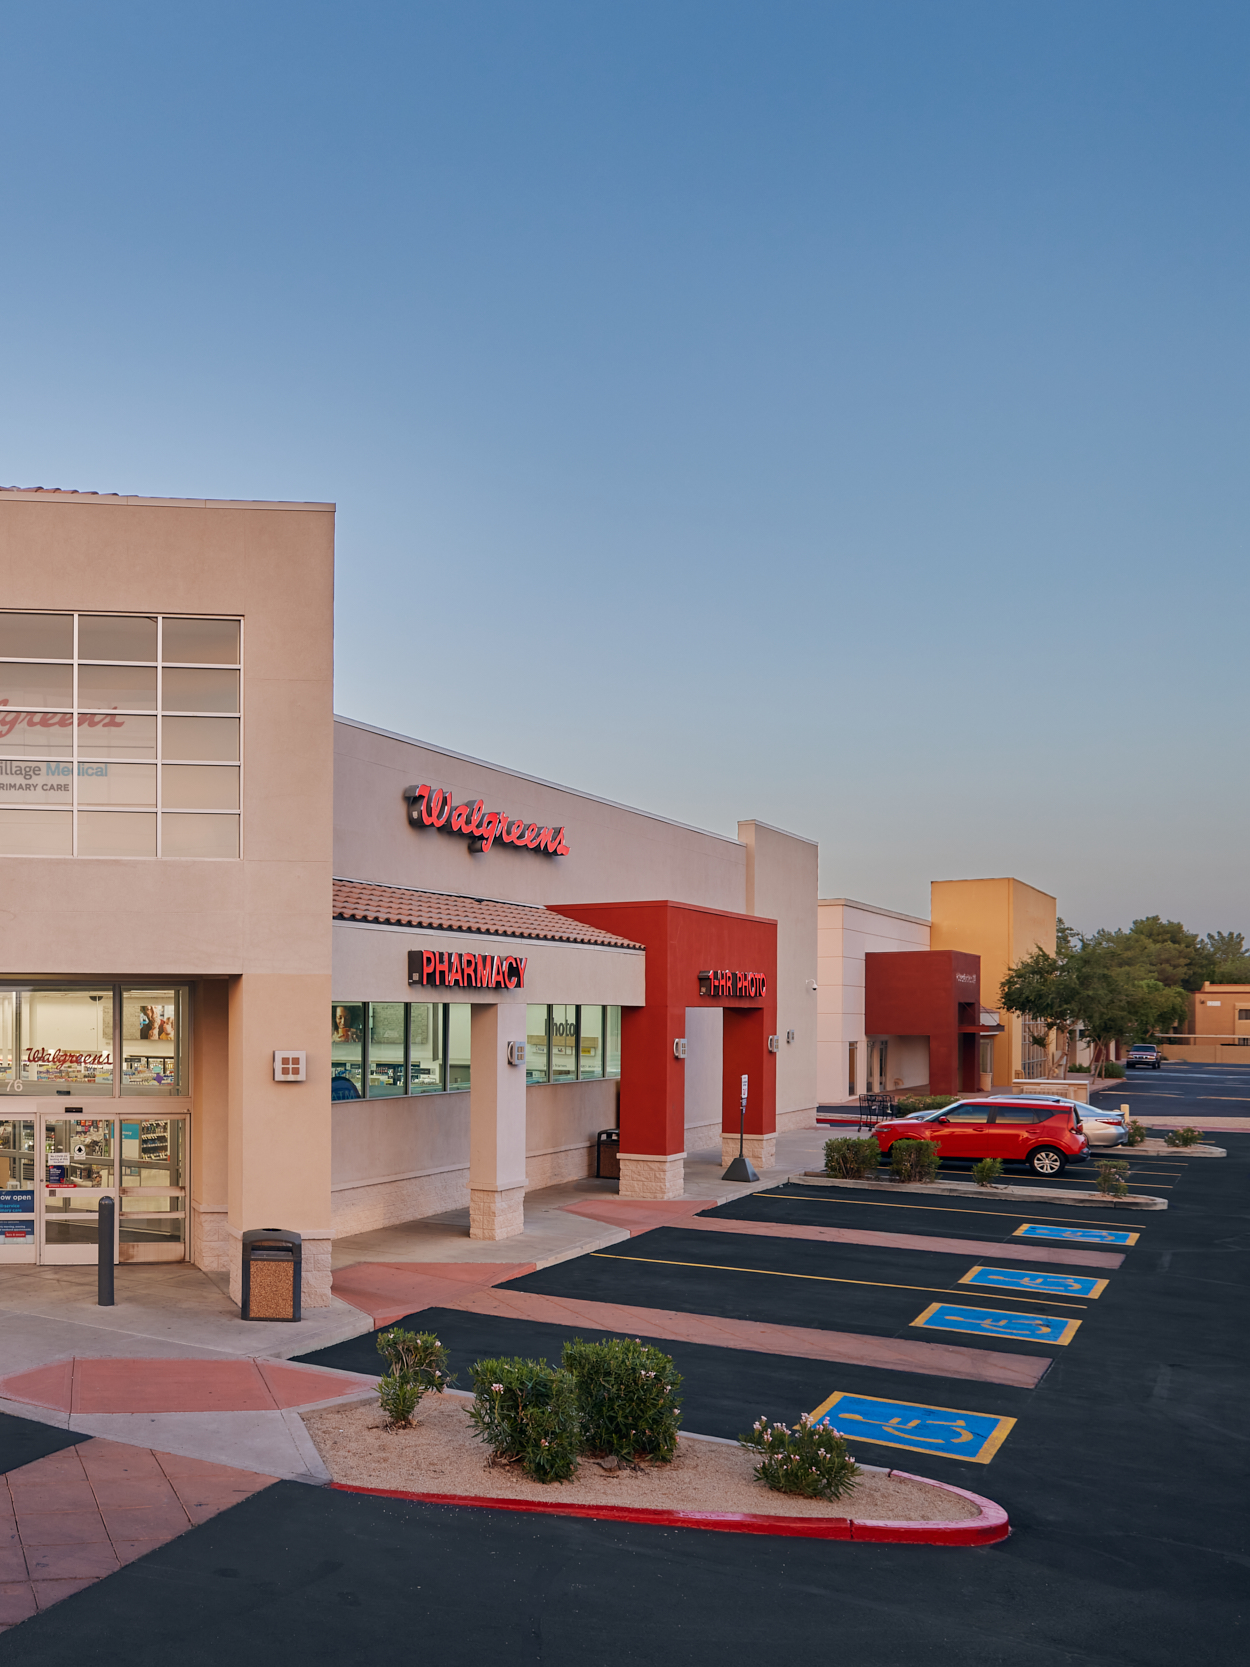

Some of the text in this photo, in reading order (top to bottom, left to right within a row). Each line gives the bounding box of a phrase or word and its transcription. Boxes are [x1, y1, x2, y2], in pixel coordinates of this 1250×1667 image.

[41, 784, 70, 792] CARE
[416, 784, 571, 856] Walgreens
[421, 949, 528, 989] PHARMACY
[707, 970, 767, 997] 1-HR PHOTO
[25, 1047, 114, 1070] Walgreens
[4, 1079, 23, 1092] 76
